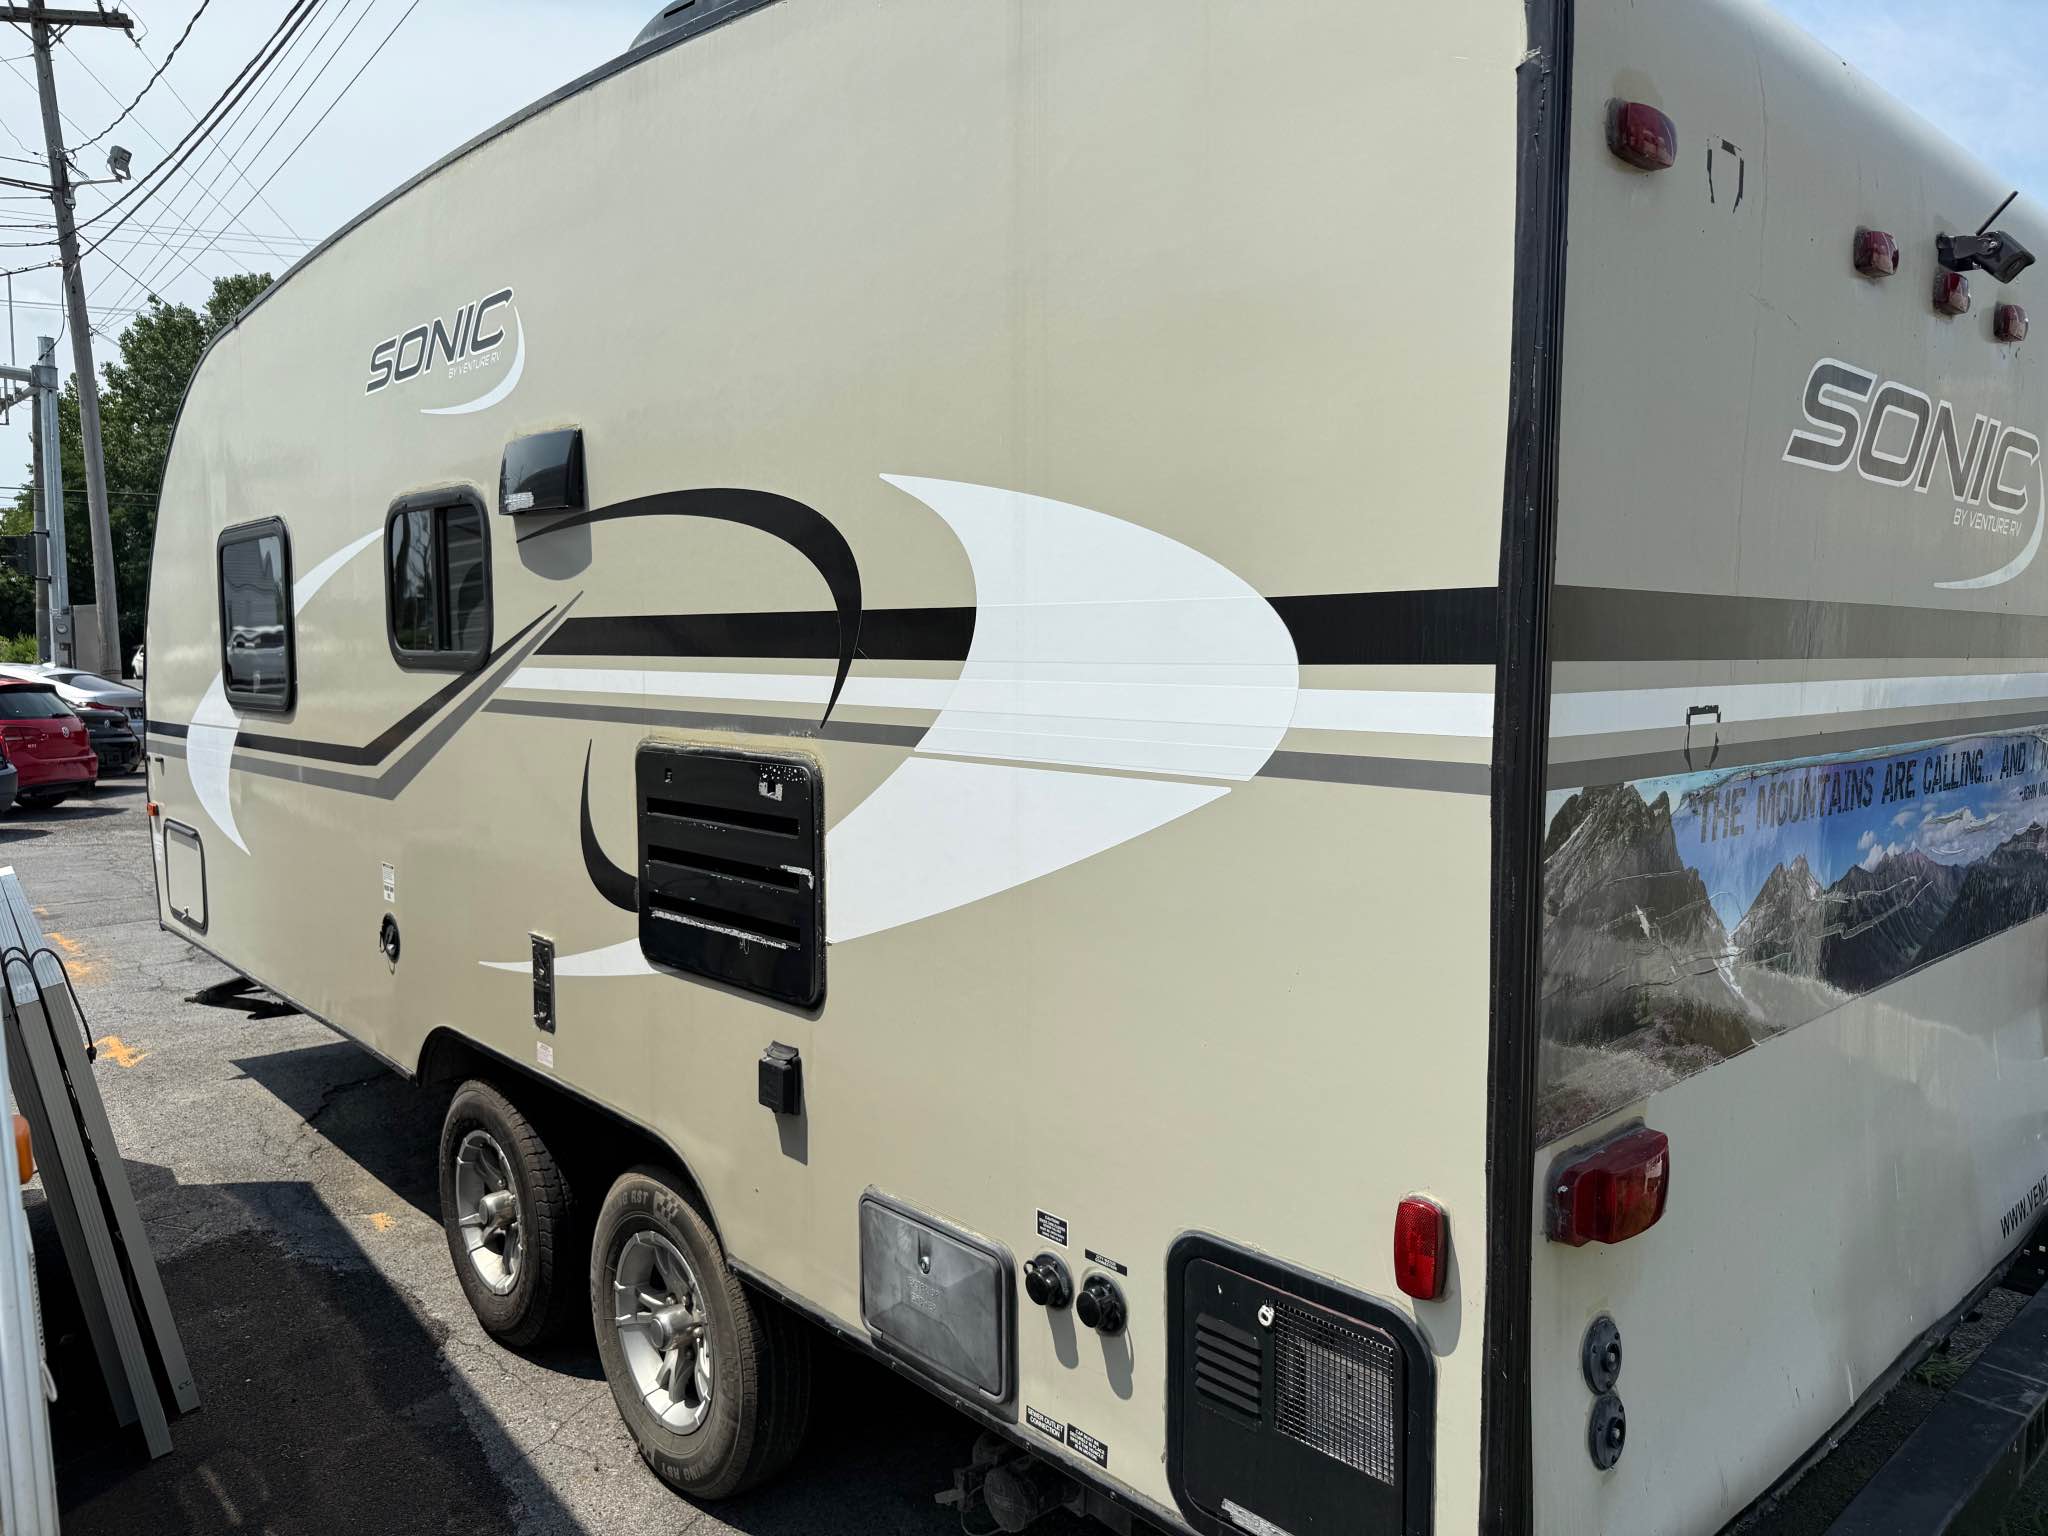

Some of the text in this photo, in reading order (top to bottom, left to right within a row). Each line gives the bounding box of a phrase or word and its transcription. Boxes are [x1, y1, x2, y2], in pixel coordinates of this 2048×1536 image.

[365, 286, 513, 395] SONIC
[1782, 357, 2041, 515] SONIC
[1953, 508, 2023, 537] BY VENTURE RV
[1756, 766, 1873, 830] MOUNTAINS
[1881, 760, 1917, 804] ARE
[2000, 742, 2026, 780] AND
[1029, 1415, 1061, 1438] CONNECTION
[1043, 1416, 1064, 1433] OUTLET
